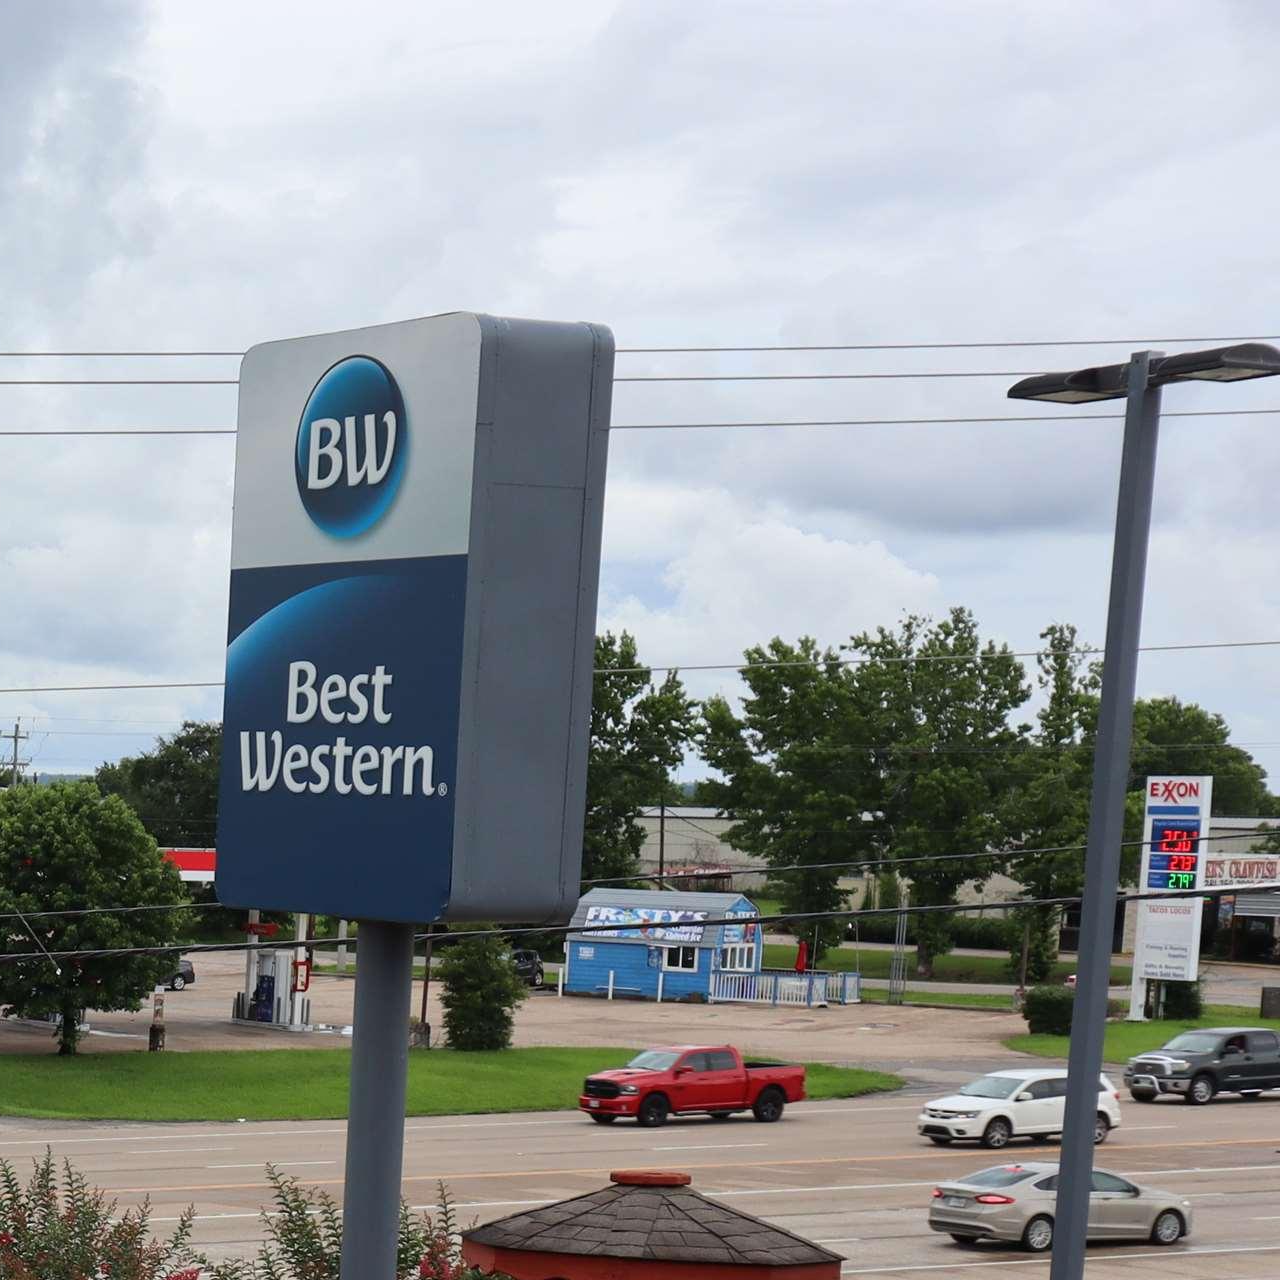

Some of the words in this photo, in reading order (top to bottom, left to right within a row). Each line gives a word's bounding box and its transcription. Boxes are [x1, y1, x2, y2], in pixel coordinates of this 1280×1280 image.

[306, 410, 398, 491] BW
[286, 661, 393, 724] Best
[239, 731, 436, 797] Western
[1150, 781, 1199, 804] EXXON
